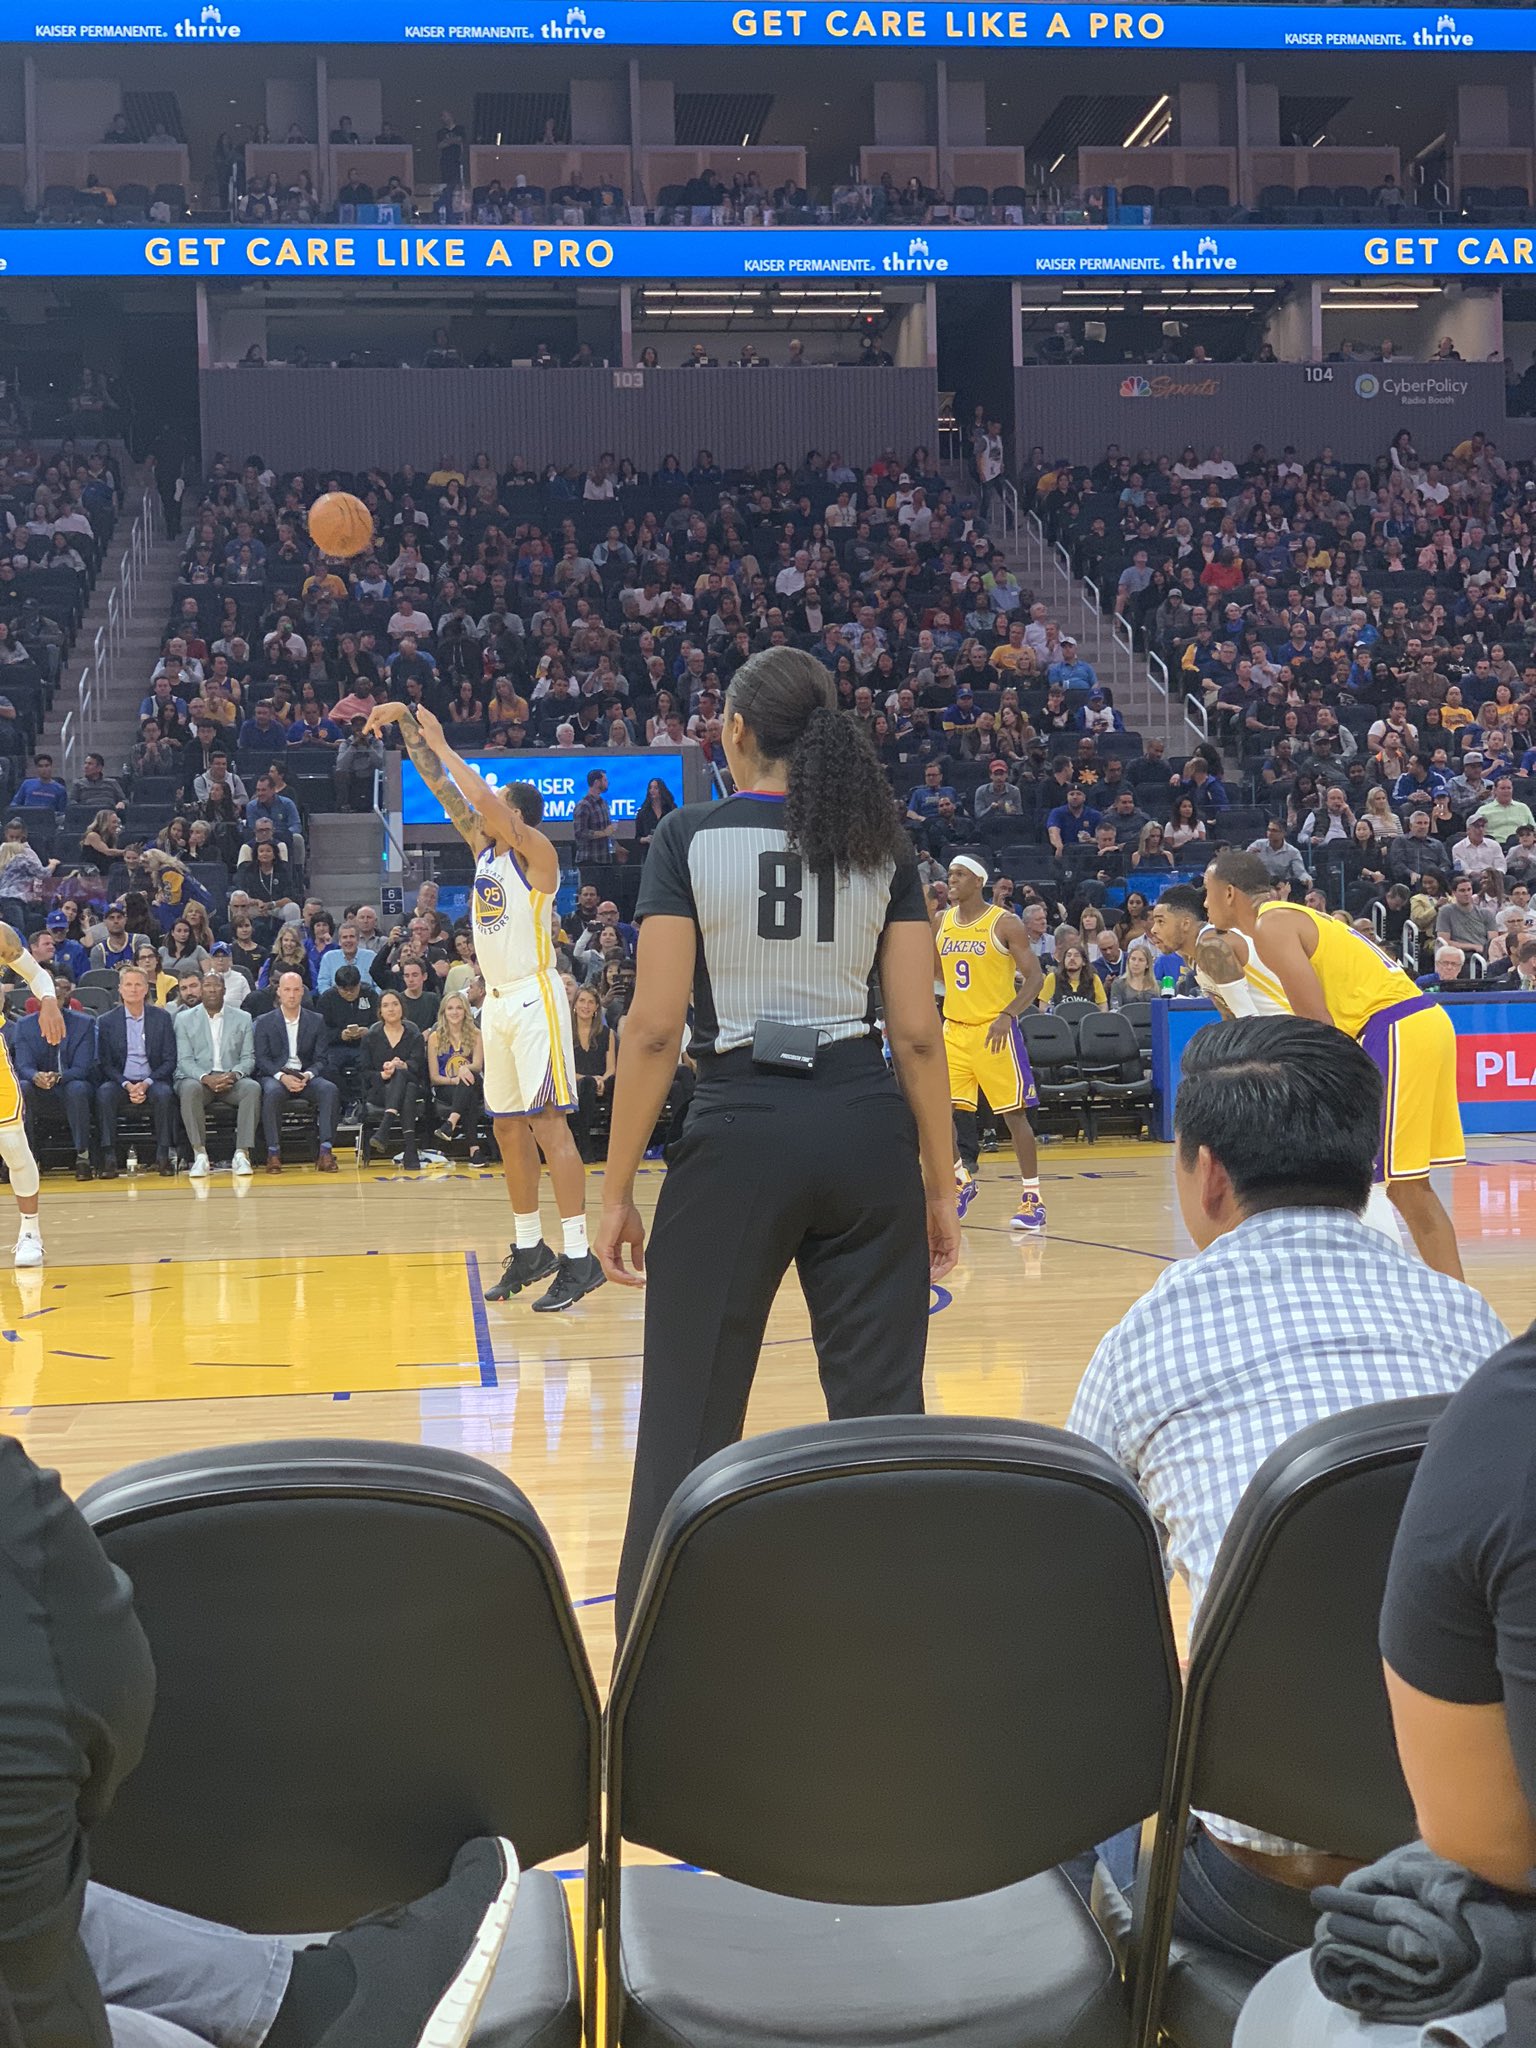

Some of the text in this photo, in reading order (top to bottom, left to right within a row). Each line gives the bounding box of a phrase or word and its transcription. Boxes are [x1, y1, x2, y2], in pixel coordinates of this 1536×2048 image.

[35, 25, 77, 37] KAISER
[174, 18, 241, 38] thrive
[405, 26, 445, 38] KAISER
[540, 20, 606, 39] thrive
[733, 10, 1165, 39] GET CARE LIKE A PRO
[1285, 33, 1323, 45] KAISER
[1412, 28, 1474, 46] thrive
[145, 238, 614, 267] GET CARE LIKE A PRO
[744, 259, 785, 271] KAISER
[882, 251, 949, 271] thrive
[1036, 258, 1076, 270] KAISER
[1171, 251, 1237, 270] thrive
[1365, 238, 1534, 265] GET CAR
[613, 372, 644, 388] 103
[1305, 367, 1334, 381] 104
[1382, 378, 1468, 395] CyberPolicy
[388, 890, 395, 899] 6
[484, 887, 501, 902] 95
[757, 851, 835, 942] 81
[389, 903, 396, 913] 5
[940, 936, 987, 956] LAKERS
[955, 959, 971, 991] 9
[1476, 1050, 1536, 1087] PL
